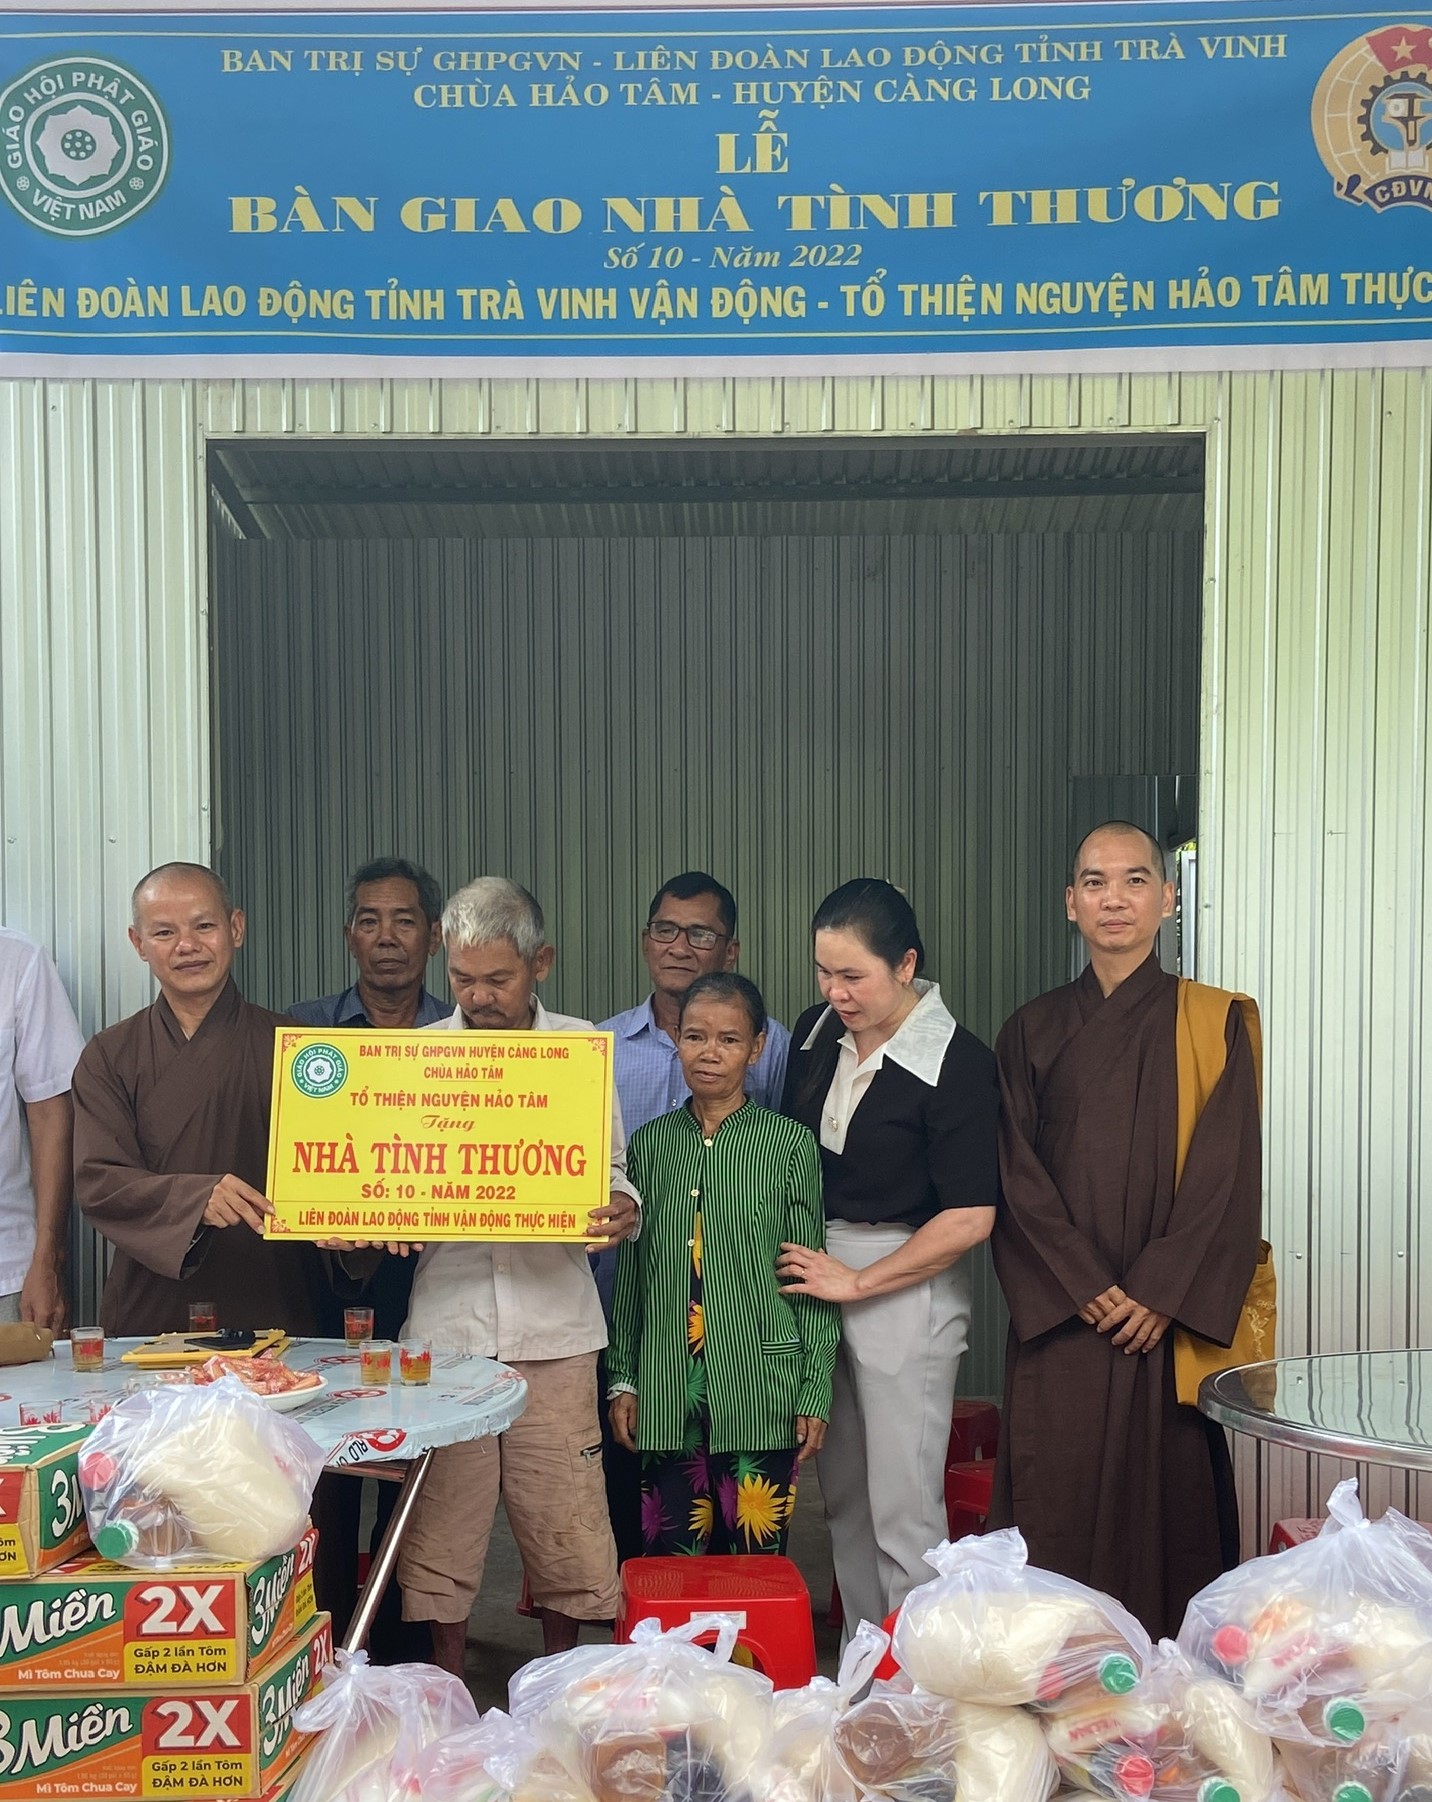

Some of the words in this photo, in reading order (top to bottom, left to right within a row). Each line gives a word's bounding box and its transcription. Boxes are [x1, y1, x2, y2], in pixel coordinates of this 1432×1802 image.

[220, 48, 295, 73] BAN
[303, 49, 364, 77] TRỊ
[375, 46, 424, 77] SỰ
[432, 50, 584, 72] GHPGVN
[612, 44, 699, 71] LIÊN
[709, 42, 811, 71] ĐOÀN
[819, 47, 892, 69] LAO
[901, 39, 1005, 71] ĐỘNG
[1014, 33, 1104, 64] TỈNH
[1113, 31, 1187, 61] TRÀ
[1197, 33, 1288, 60] VINH
[413, 76, 518, 109] CHÙA
[528, 74, 610, 107] HẢO
[619, 76, 700, 106] TÂM
[732, 75, 864, 111] HUYỆN
[873, 72, 978, 103] CÀNG
[989, 75, 1092, 101] LONG
[2, 105, 26, 169] GIÁO
[23, 74, 65, 105] HỘI
[71, 71, 136, 105] PHẬT
[130, 109, 159, 172] GIÁO
[714, 108, 789, 174] LỄ
[32, 188, 76, 221] VIỆT
[78, 189, 128, 221] NAM
[227, 184, 380, 233] BÀN
[399, 196, 583, 234] GIAO
[601, 184, 754, 233] NHÀ
[777, 182, 958, 231] TÌNH
[978, 176, 1282, 226] THƯƠNG
[603, 242, 644, 269] Số
[647, 246, 684, 269] 10
[708, 245, 781, 269] Năm
[788, 243, 863, 267] 2022
[0, 278, 65, 318] IÊN
[76, 277, 169, 319] ĐOÀN
[180, 284, 247, 317] LAO
[257, 279, 355, 324] ĐỘNG
[364, 277, 445, 321] TỈNH
[455, 279, 525, 321] TRÀ
[536, 287, 617, 320] VINH
[629, 278, 698, 326] VẬN
[710, 278, 806, 325] ĐỘNG
[817, 301, 829, 309] -
[839, 267, 888, 317] TỔ
[897, 273, 1003, 323] THIỆN
[1015, 272, 1155, 319] NGUYỆN
[1168, 265, 1241, 310] HẢO
[1251, 265, 1329, 307] TÂM
[1340, 265, 1432, 310] THỰC
[360, 1045, 381, 1057] BAN
[385, 1045, 402, 1060] TRỊ
[405, 1044, 419, 1060] SỰ
[422, 1046, 465, 1057] GHPGVN
[469, 1044, 505, 1061] HUYỆN
[508, 1045, 537, 1058] CÀNG
[541, 1047, 569, 1059] LONG
[424, 1064, 452, 1079] CHÙA
[456, 1063, 478, 1079] HẢO
[481, 1065, 503, 1079] TÂM
[350, 1086, 369, 1106] TỔ
[374, 1090, 416, 1109] THIỆN
[421, 1091, 480, 1110] NGUYỆN
[485, 1089, 513, 1108] HẢO
[518, 1091, 548, 1108] TÂM
[421, 1115, 474, 1132] Tặng
[292, 1133, 359, 1173] NHÀ
[370, 1133, 447, 1174] TÌNH
[458, 1138, 587, 1176] THƯƠNG
[361, 1178, 389, 1198] SỐ:
[396, 1184, 415, 1199] 10
[431, 1181, 470, 1199] NĂM
[476, 1185, 516, 1200] 2022
[299, 1208, 324, 1225] LIÊN
[328, 1208, 359, 1226] ĐOÀN
[362, 1211, 385, 1226] LAO
[388, 1208, 419, 1230] ĐỘNG
[423, 1207, 450, 1227] TỈNH
[453, 1209, 476, 1231] VẬN
[479, 1210, 511, 1231] ĐỘNG
[514, 1211, 545, 1232] THỰC
[548, 1211, 575, 1232] HIỆN
[139, 1585, 226, 1634] 2X
[134, 1646, 160, 1660] Gấp
[163, 1647, 171, 1657] 2
[198, 1645, 227, 1656] Tôm
[18, 1669, 33, 1680] Mì
[34, 1669, 61, 1679] Tôm
[64, 1668, 96, 1679] Chua
[97, 1667, 121, 1680] Cay
[134, 1661, 167, 1676] ĐẬM
[170, 1660, 193, 1673] ĐÀ
[196, 1661, 227, 1672] HƠN
[156, 1699, 242, 1749] 2X
[151, 1760, 177, 1774] Gấp
[180, 1762, 189, 1771] 2
[215, 1760, 243, 1770] Tôm
[36, 1784, 52, 1794] Mì
[53, 1782, 80, 1793] Tôm
[81, 1781, 113, 1792] Chua
[115, 1781, 138, 1794] Cay
[152, 1775, 185, 1791] ĐẬM
[188, 1774, 210, 1788] ĐÀ
[212, 1775, 243, 1788] HƠN
